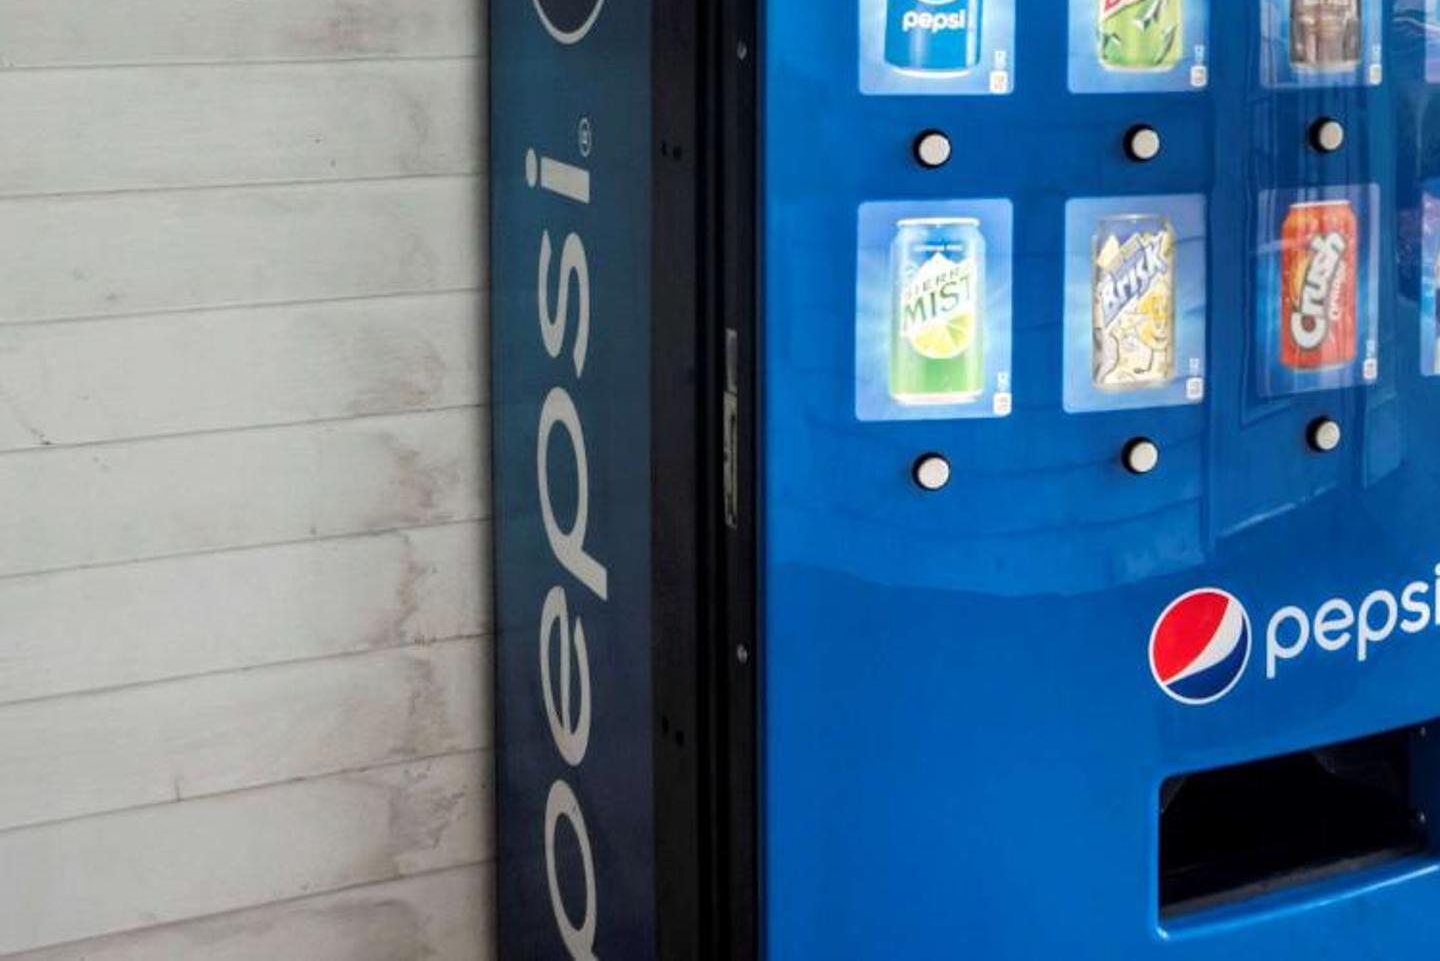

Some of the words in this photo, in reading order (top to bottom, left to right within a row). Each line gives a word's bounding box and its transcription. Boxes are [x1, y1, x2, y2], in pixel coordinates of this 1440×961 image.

[902, 9, 967, 33] pepsi
[903, 275, 970, 330] MIST
[1289, 229, 1346, 350] Crush
[525, 146, 609, 961] pepsi
